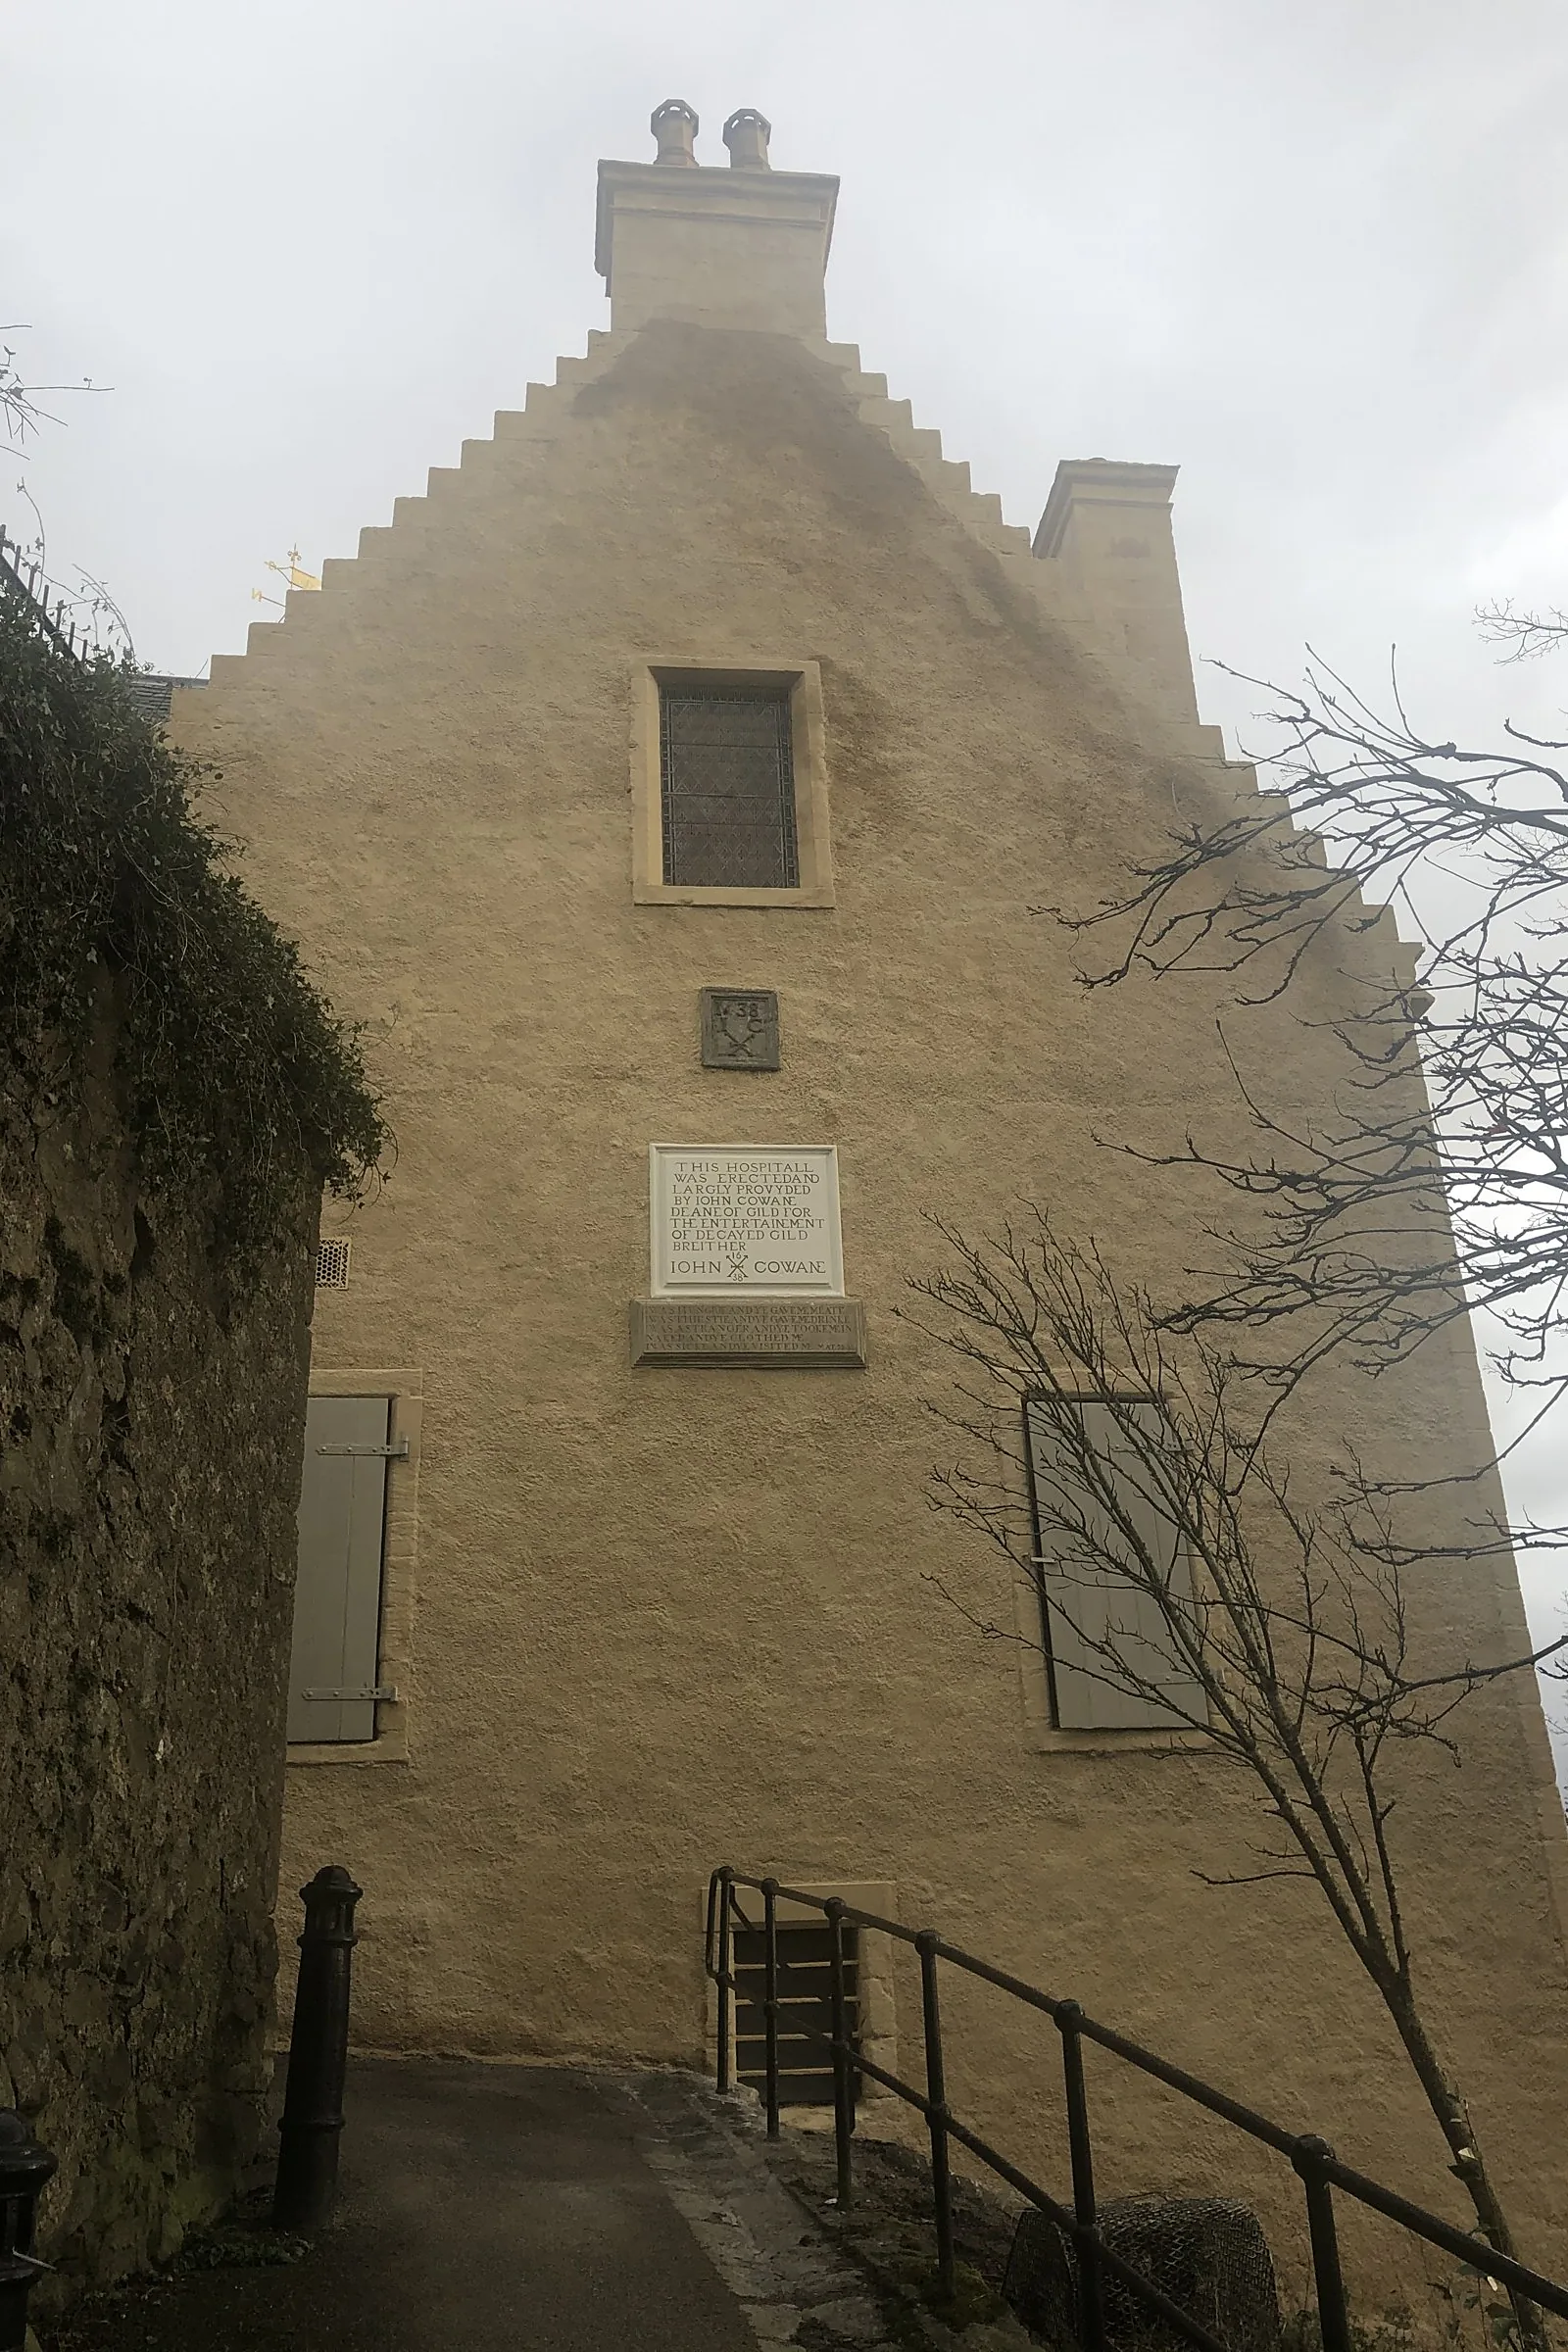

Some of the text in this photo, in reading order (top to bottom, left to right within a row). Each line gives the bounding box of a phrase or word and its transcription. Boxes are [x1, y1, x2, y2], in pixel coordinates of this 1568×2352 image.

[675, 1162, 813, 1172] THIS HOSPITALL
[674, 1174, 707, 1183] WAS
[672, 1185, 810, 1195] LARGLY PROVYDED
[674, 1197, 796, 1205] BY IOHN COWANE
[747, 1207, 779, 1217] GILD
[784, 1207, 811, 1217] FOR
[670, 1219, 825, 1228] THE ENTERTAINEMENT
[672, 1230, 808, 1240] OF DECAYED GILD
[673, 1242, 746, 1250] BREITHER
[671, 1261, 825, 1274] IOHN COWANE
